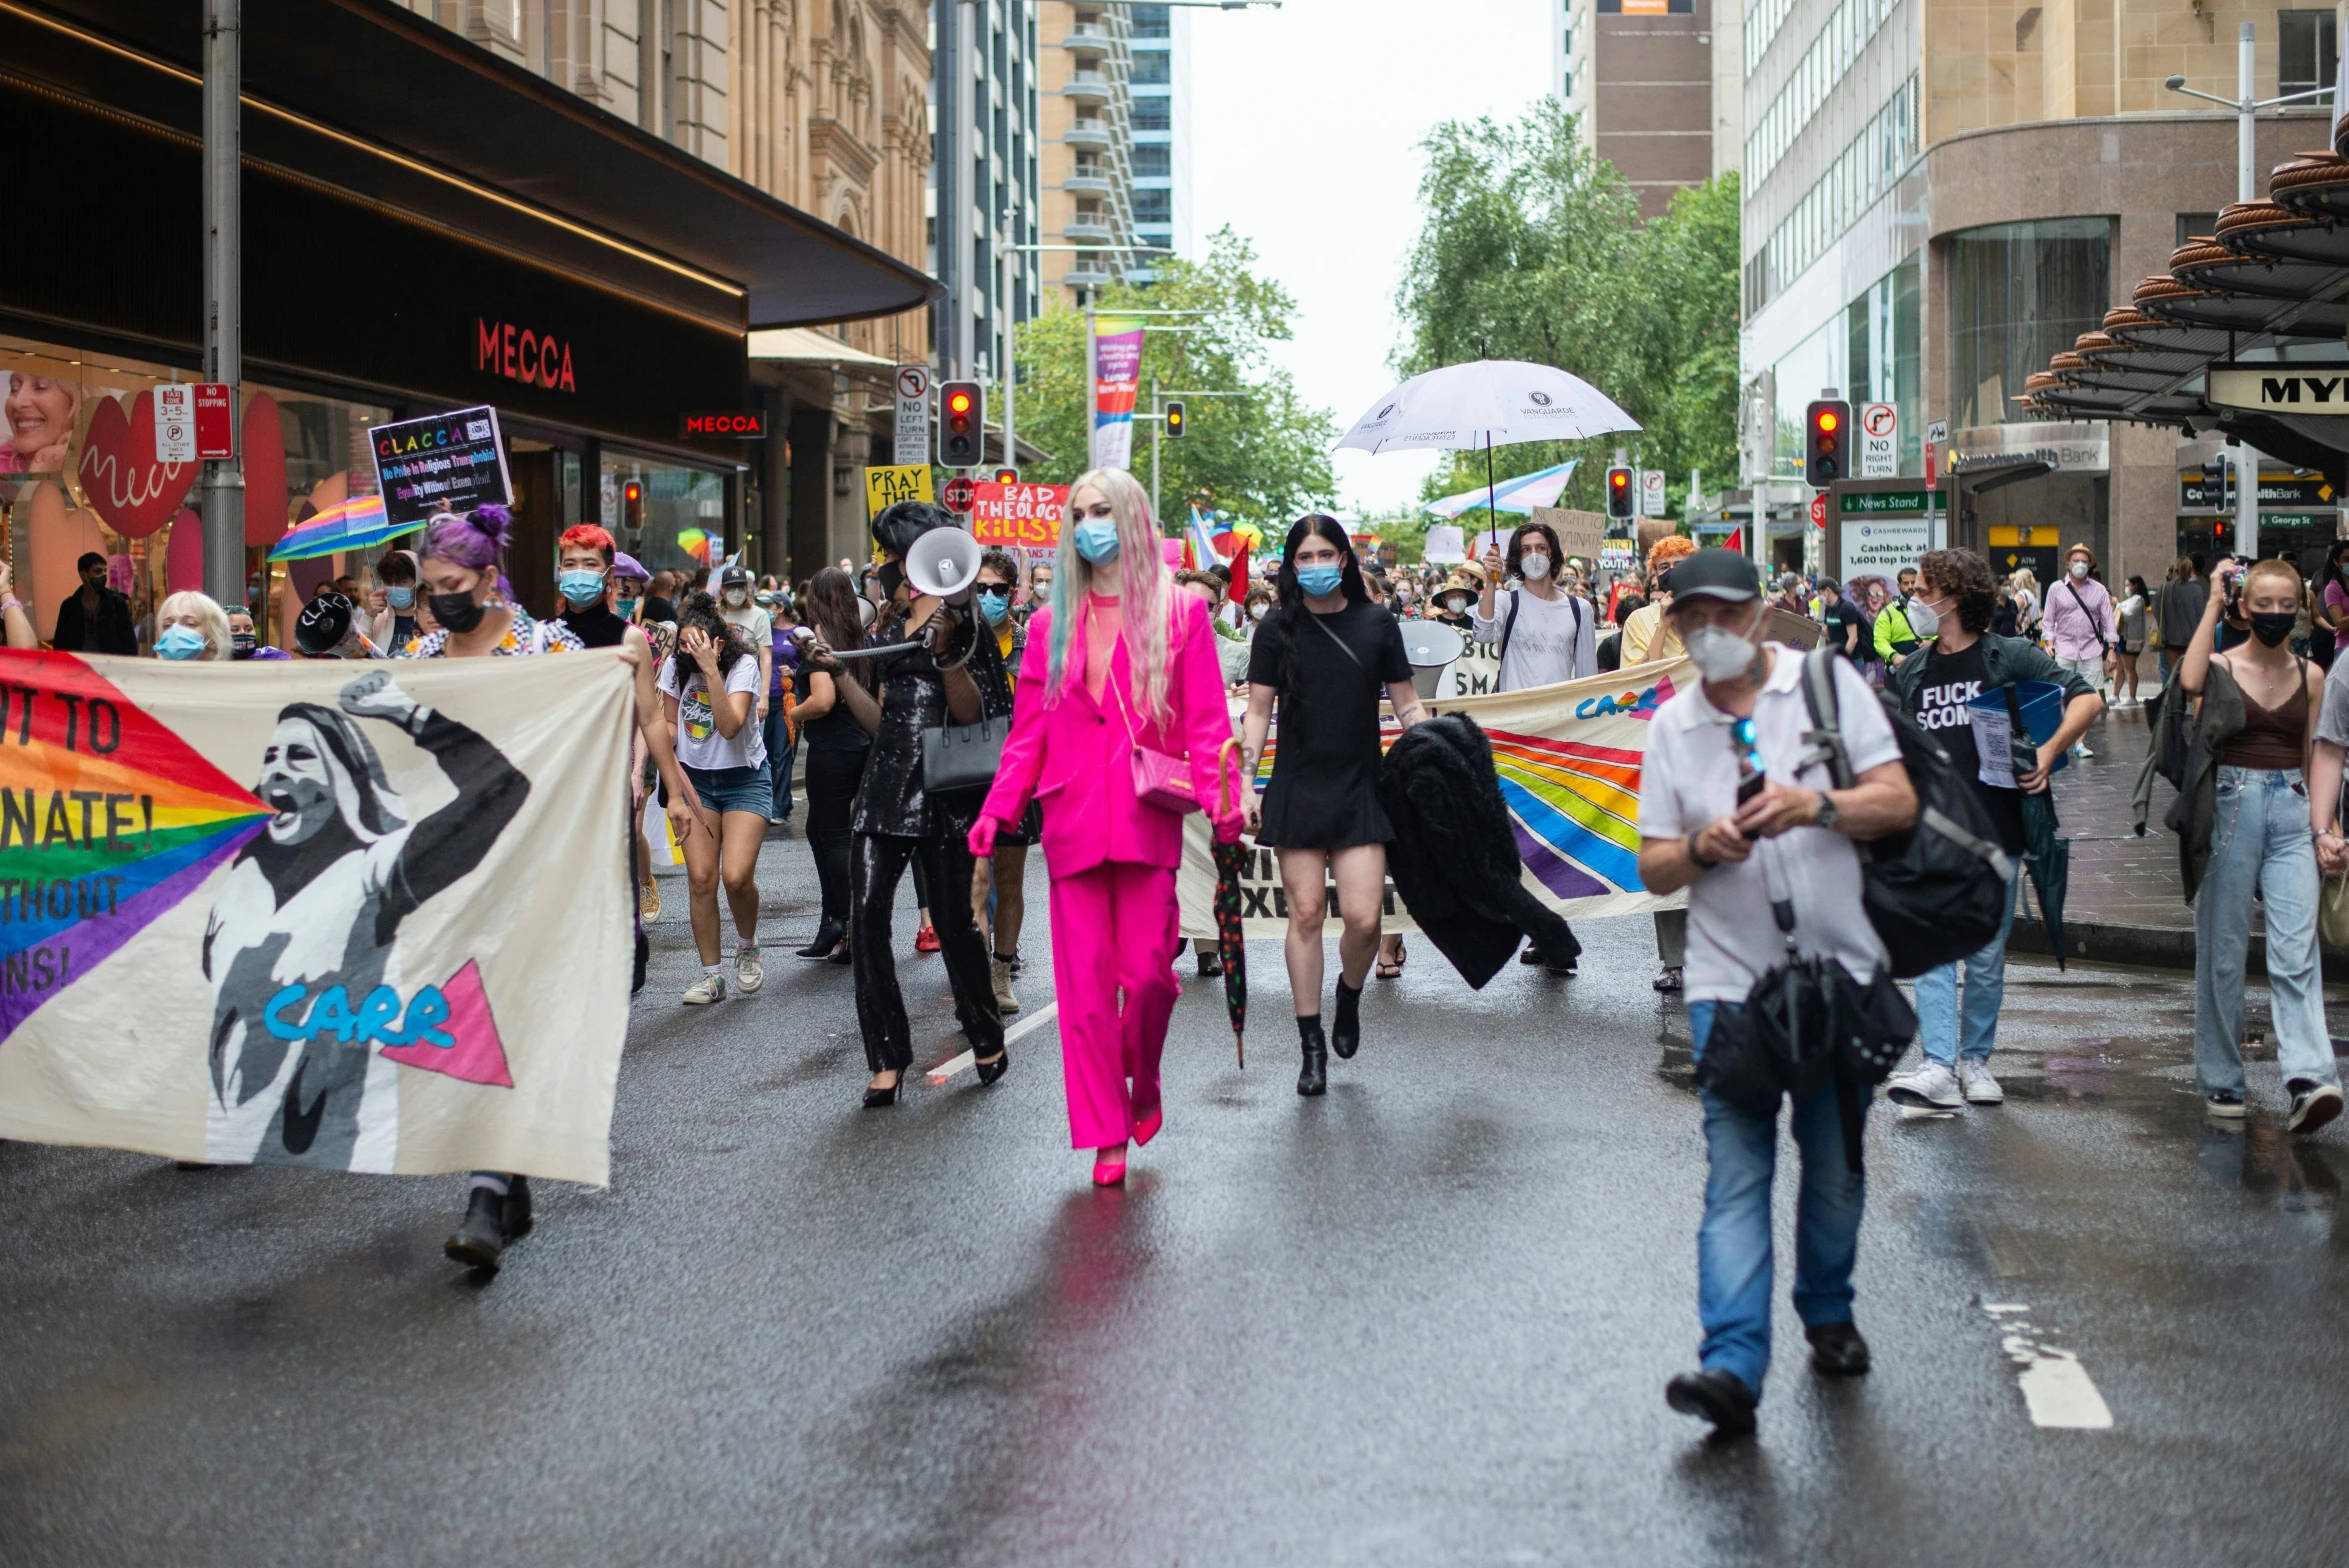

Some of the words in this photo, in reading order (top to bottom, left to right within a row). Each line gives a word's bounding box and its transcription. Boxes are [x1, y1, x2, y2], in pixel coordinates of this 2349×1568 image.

[479, 316, 576, 393] MECCA
[207, 388, 217, 396] NO
[198, 399, 227, 407] STOPPING
[903, 401, 921, 412] NO
[1520, 407, 1576, 415] VANGUARDE
[687, 416, 760, 432] MECCA
[900, 415, 923, 424] LEFT
[900, 426, 925, 434] TURN
[380, 427, 463, 455] CLACCA
[1869, 441, 1889, 451] NO
[1865, 455, 1893, 463] RIGHT
[2061, 447, 2099, 464] Bank
[382, 467, 394, 480] No
[393, 463, 411, 479] Pride
[419, 459, 452, 474] Religious
[872, 469, 923, 492] PRAY
[396, 483, 424, 500] Equality
[423, 478, 452, 494] Without
[1004, 486, 1055, 502] BAD
[1859, 497, 1887, 509] News
[1889, 496, 1918, 508] Stand
[977, 501, 1066, 520] THEOLOGY
[1556, 511, 1585, 528] RIGHT
[1589, 513, 1604, 529] TO
[2272, 516, 2300, 525] George
[2302, 516, 2311, 524] St
[1861, 543, 1913, 553] Cashback
[1916, 543, 1928, 552] at
[1597, 559, 1630, 570] YOUTH
[1850, 556, 1877, 566] 1,600
[1879, 556, 1898, 566] top
[2020, 557, 2036, 565] ATM
[1922, 681, 1983, 709] FUCK
[1576, 687, 1659, 720] CARR
[55, 693, 121, 755] TO
[263, 983, 456, 1048] CARR
